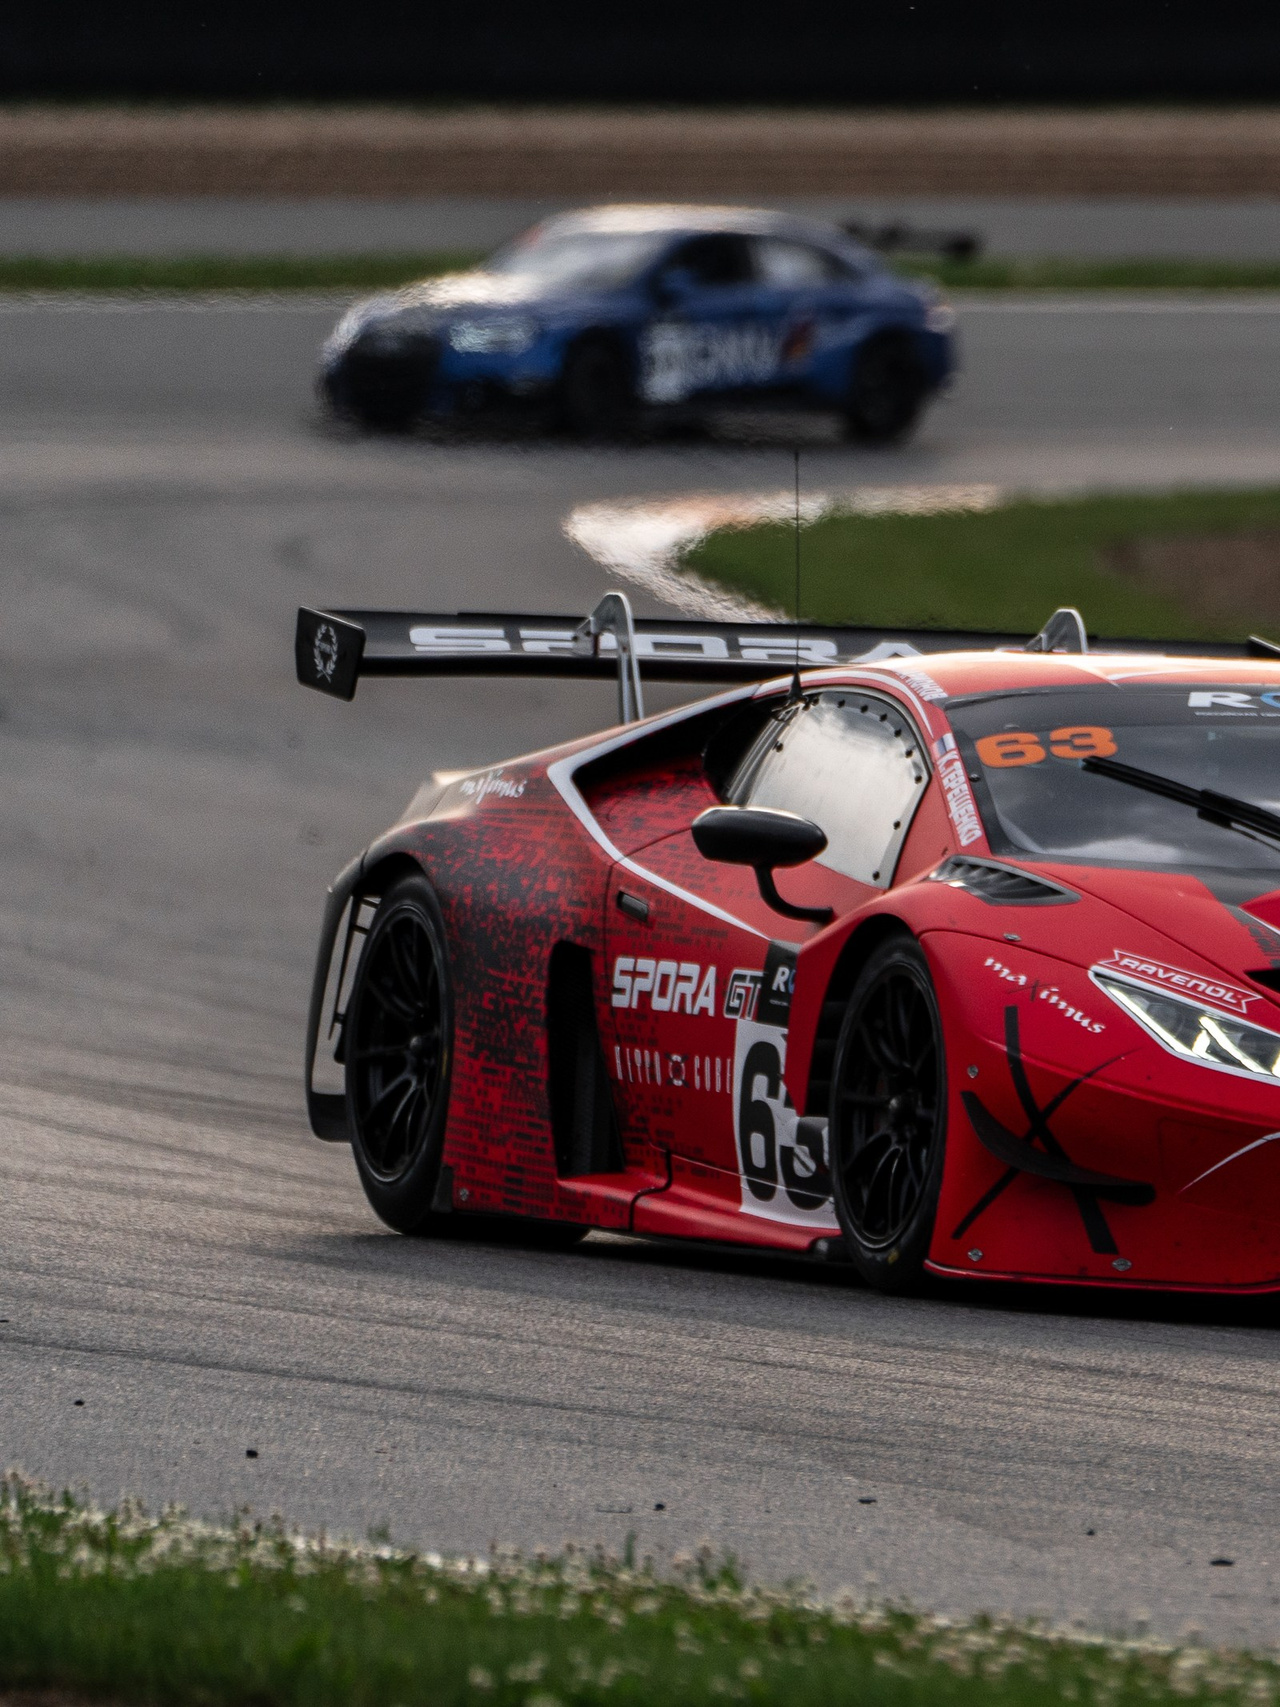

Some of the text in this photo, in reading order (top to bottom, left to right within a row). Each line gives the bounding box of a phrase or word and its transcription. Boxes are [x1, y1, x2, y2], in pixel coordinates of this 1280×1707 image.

[409, 627, 928, 663] SPORA
[974, 726, 1118, 768] 63
[611, 957, 717, 1017] SPORA
[1117, 957, 1243, 1005] RAVENOL
